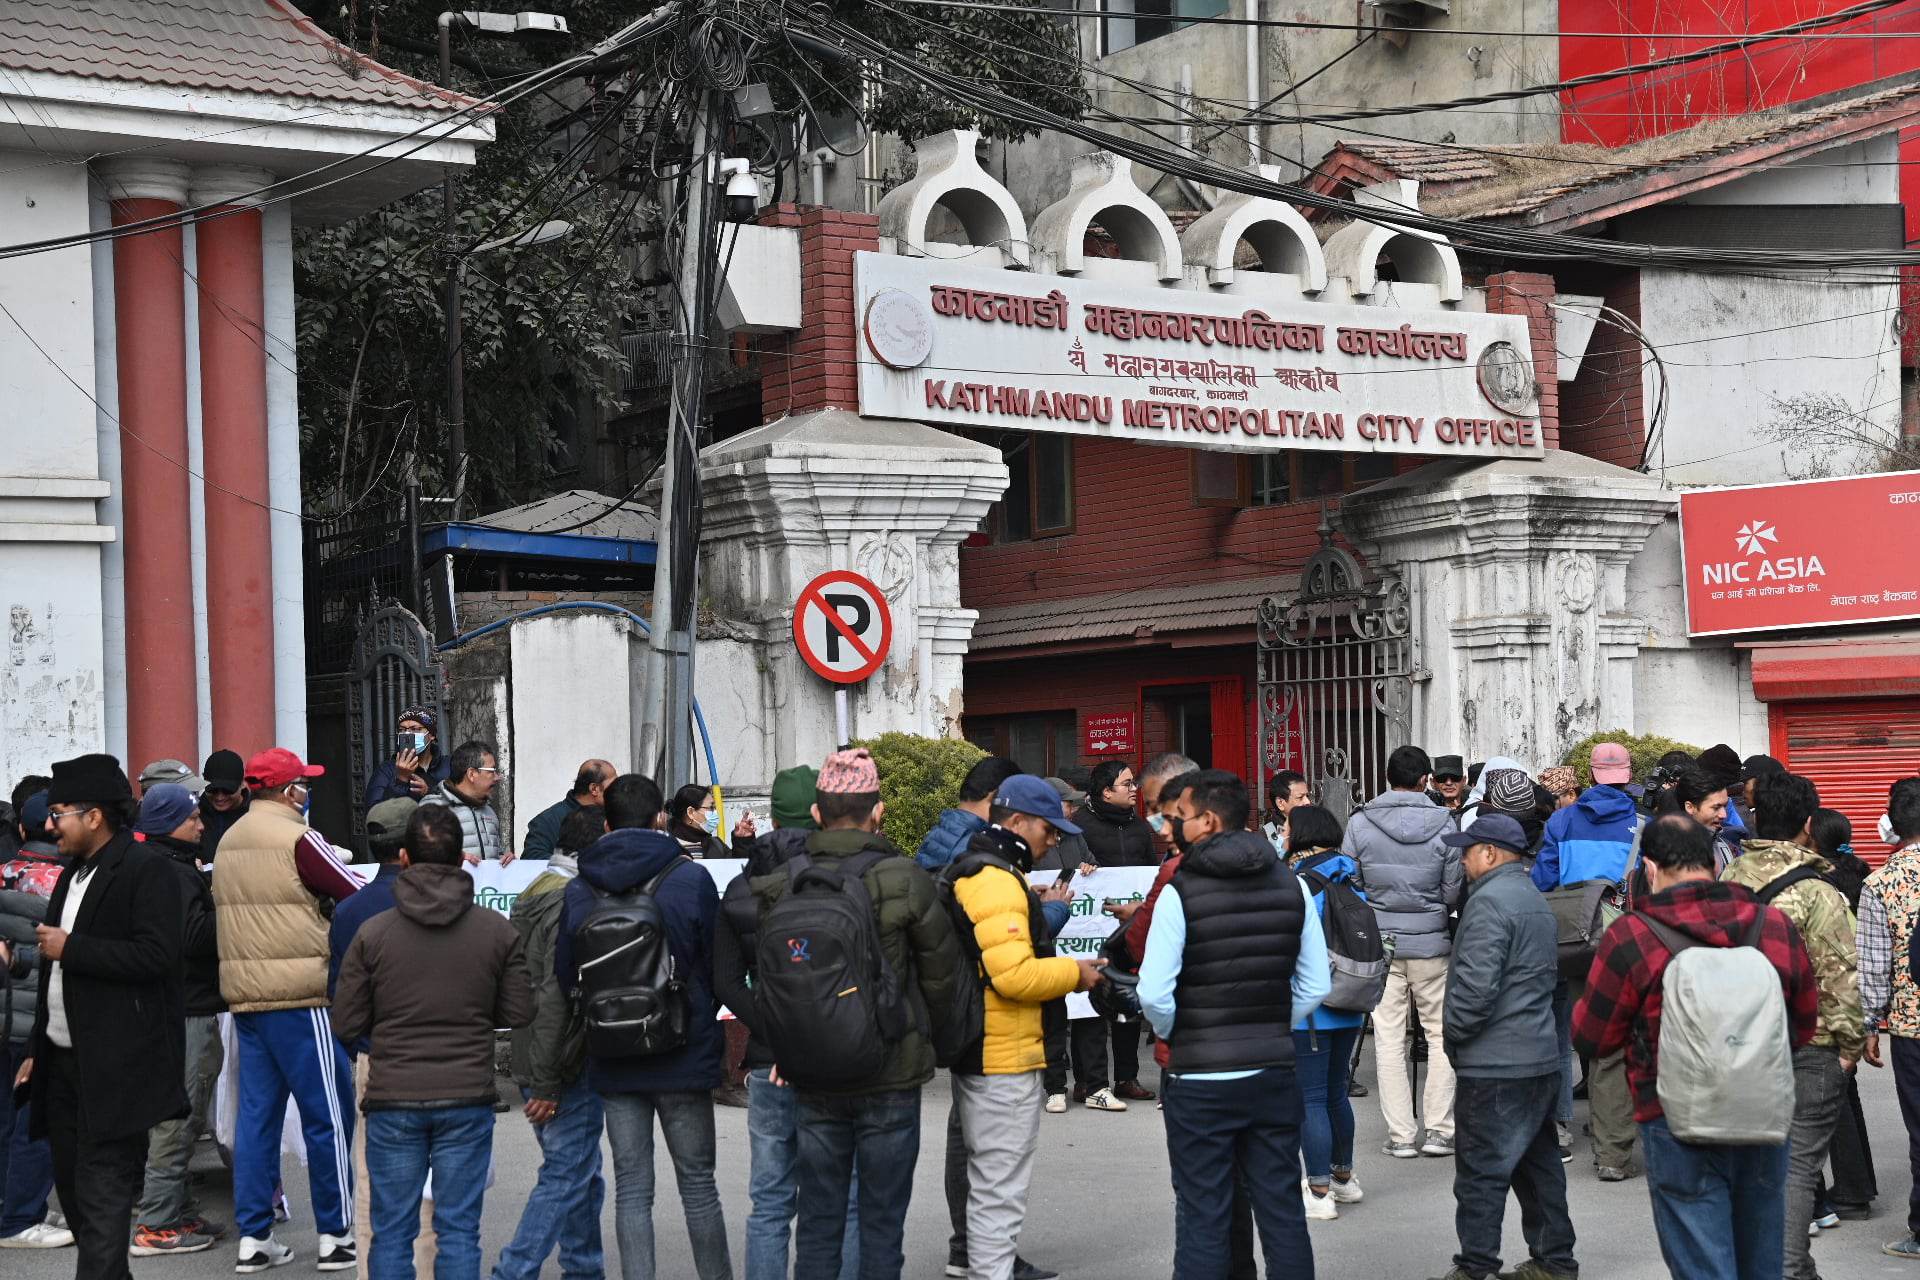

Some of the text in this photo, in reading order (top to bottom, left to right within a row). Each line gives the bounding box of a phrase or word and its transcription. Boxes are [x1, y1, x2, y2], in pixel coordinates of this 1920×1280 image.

[1084, 303, 1326, 352] महानगरपालिका
[1337, 323, 1467, 360] कार्यालय
[925, 379, 1536, 446] KATHMANDU METROPOLITAN CITY OFFICE
[1888, 491, 1920, 504] काठ
[1702, 556, 1826, 585] NIC ASIA
[1830, 595, 1857, 606] नेपाल
[825, 594, 870, 662] P
